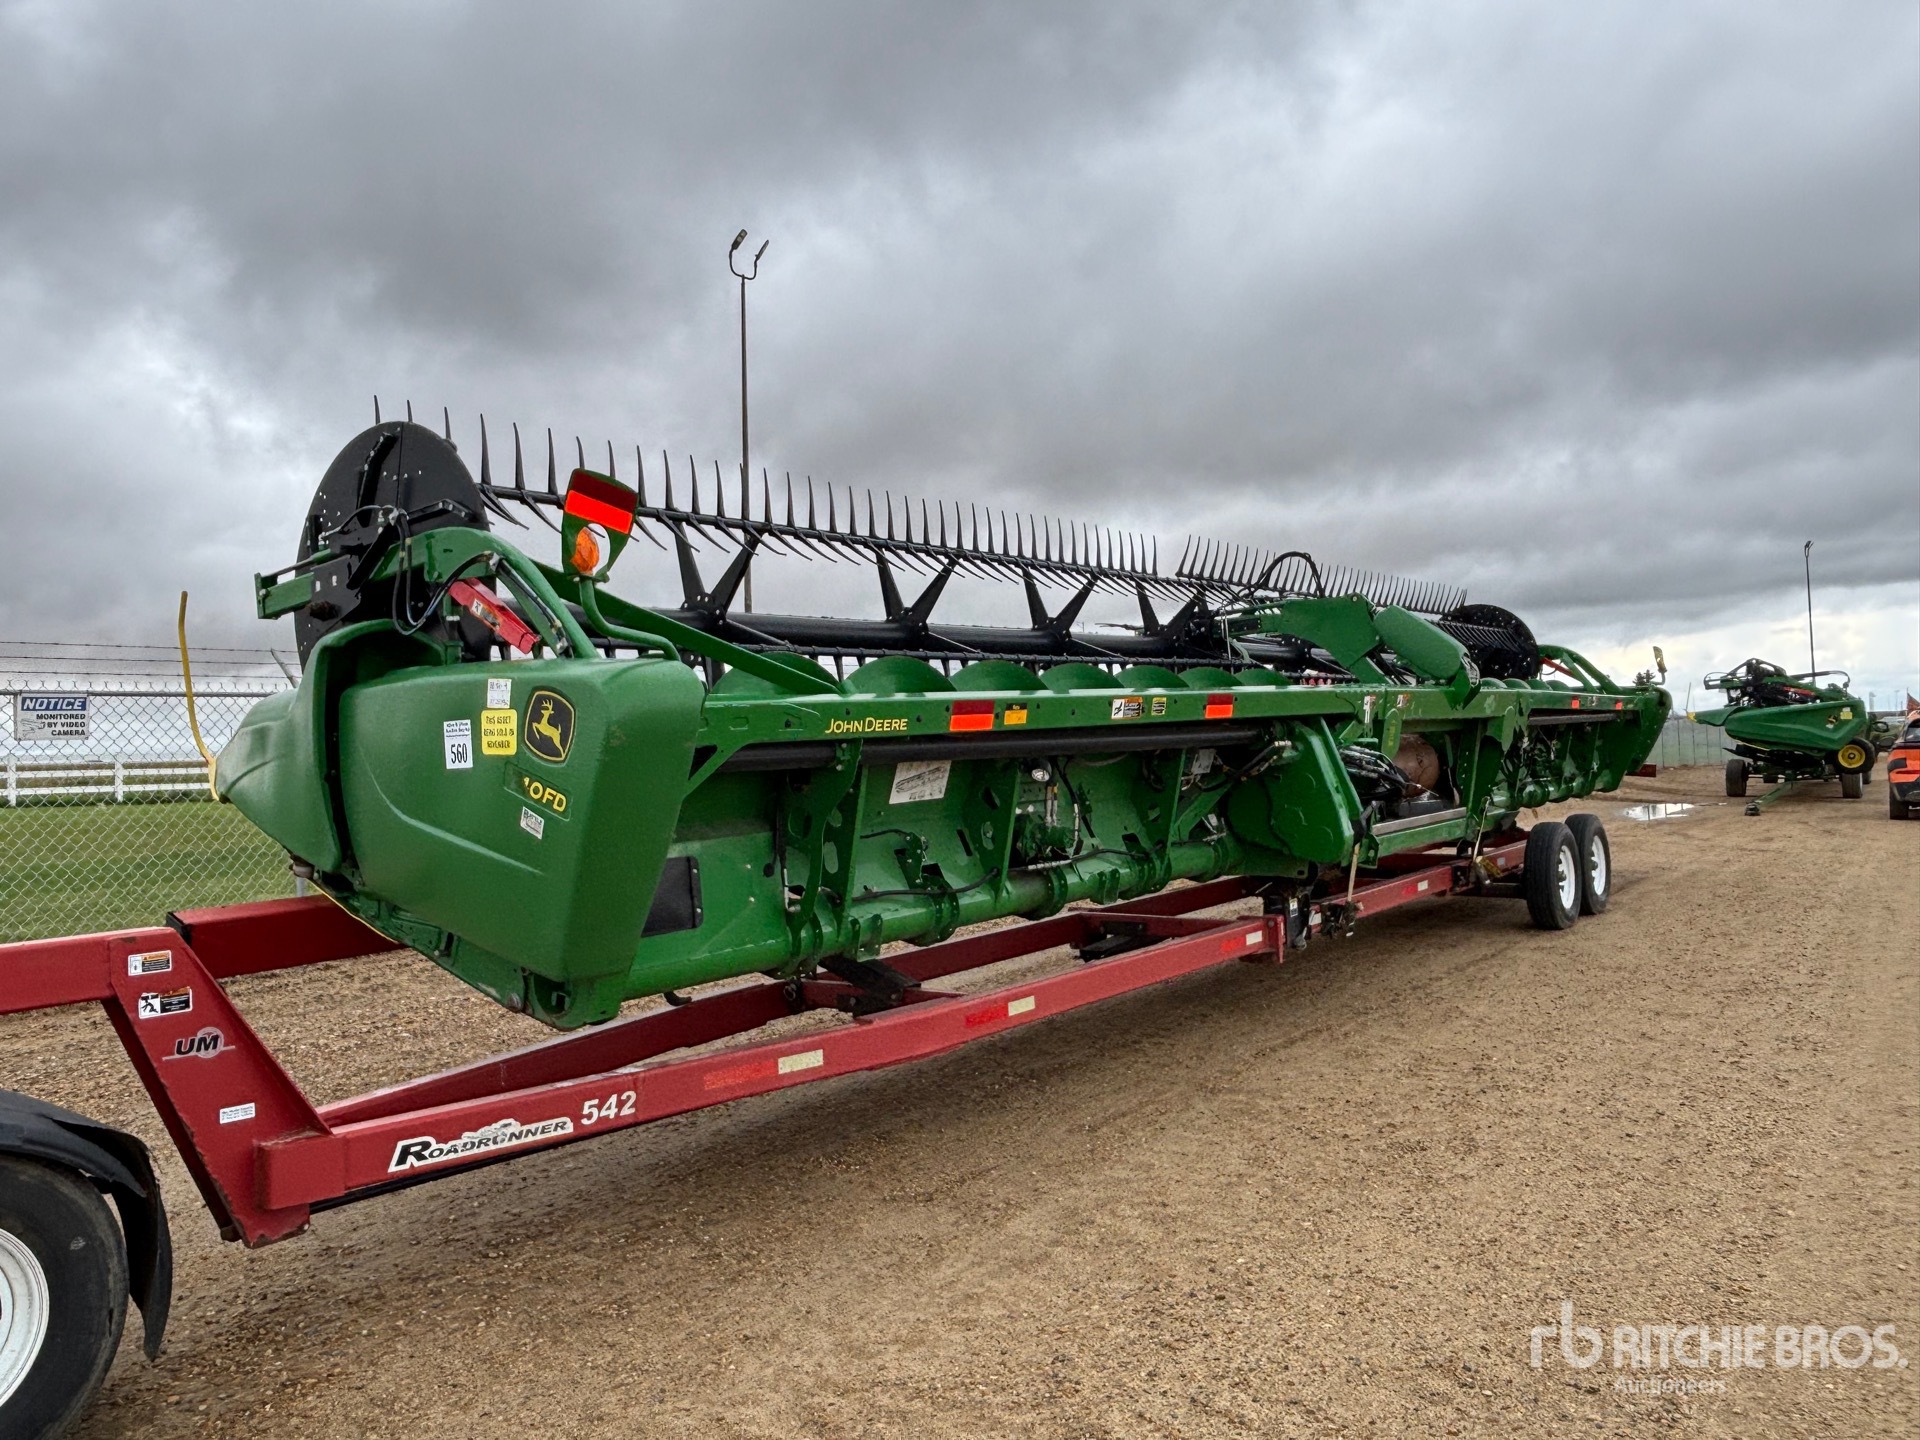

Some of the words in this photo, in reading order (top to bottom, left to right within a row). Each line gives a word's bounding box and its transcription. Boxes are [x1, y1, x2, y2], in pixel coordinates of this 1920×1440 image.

[23, 698, 85, 710] NOTICE
[823, 718, 863, 734] JOHN
[864, 717, 908, 732] DEERE
[450, 743, 468, 764] 560
[175, 1034, 220, 1055] UM
[580, 1090, 638, 1126] 542
